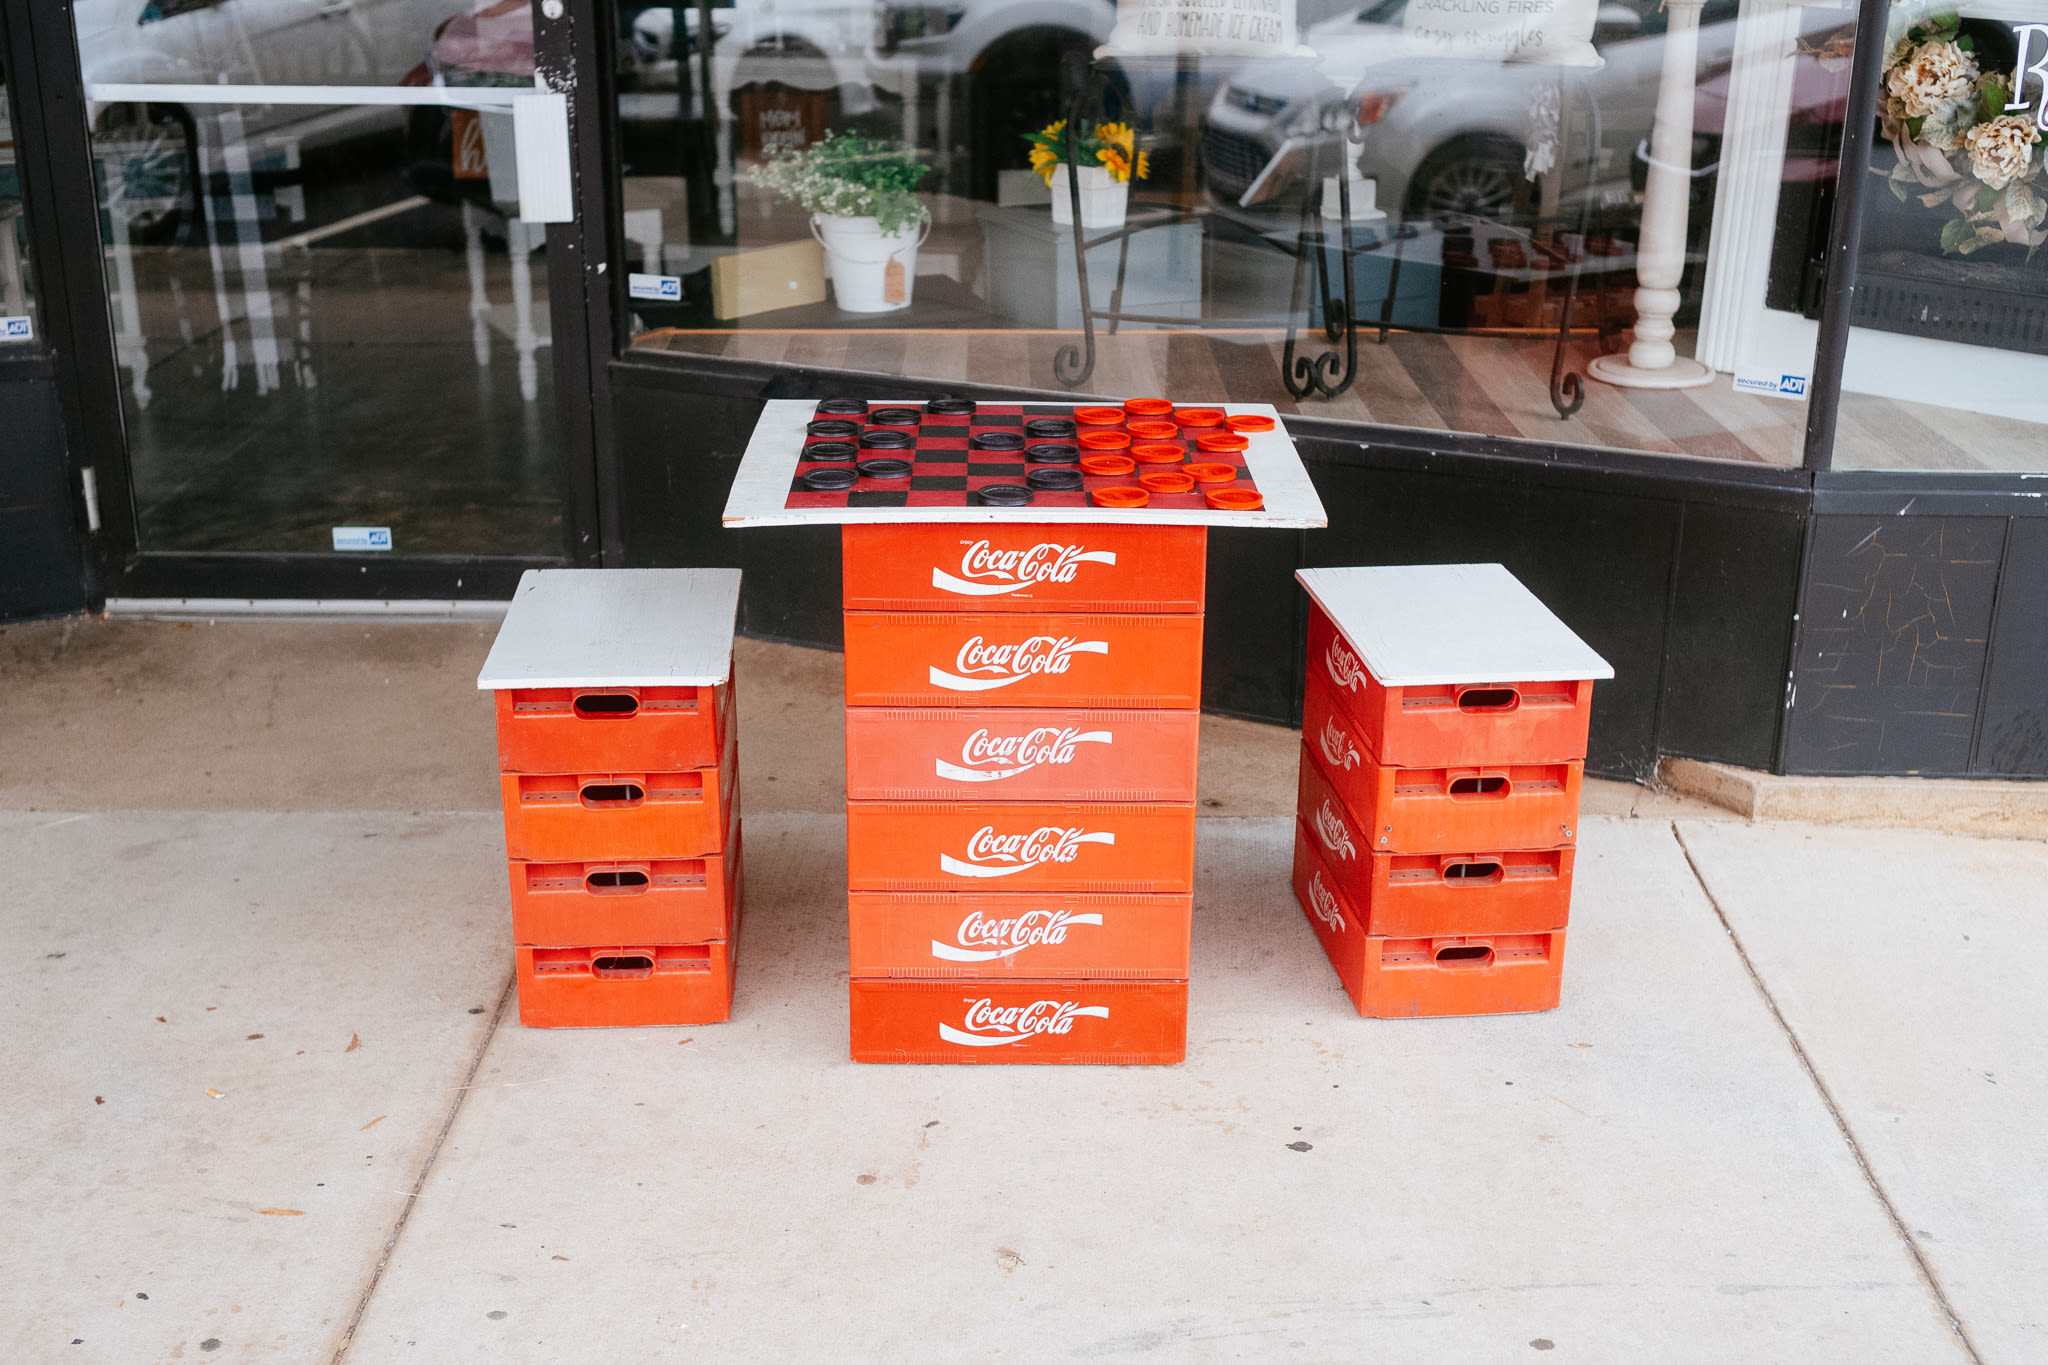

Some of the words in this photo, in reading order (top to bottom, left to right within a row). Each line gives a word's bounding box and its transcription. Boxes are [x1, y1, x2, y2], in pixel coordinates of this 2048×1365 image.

[1415, 0, 1500, 14] CRACKLING
[1507, 0, 1554, 14] FIRES
[1780, 376, 1805, 394] ADT
[961, 540, 1084, 583] Coca-Cola
[956, 636, 1077, 674] Coca-Cola
[962, 727, 1080, 765] Coca-Cola
[967, 826, 1084, 863] Coca-Cola
[957, 909, 1073, 946] Coca-Cola
[964, 998, 1080, 1035] Coca-Cola
